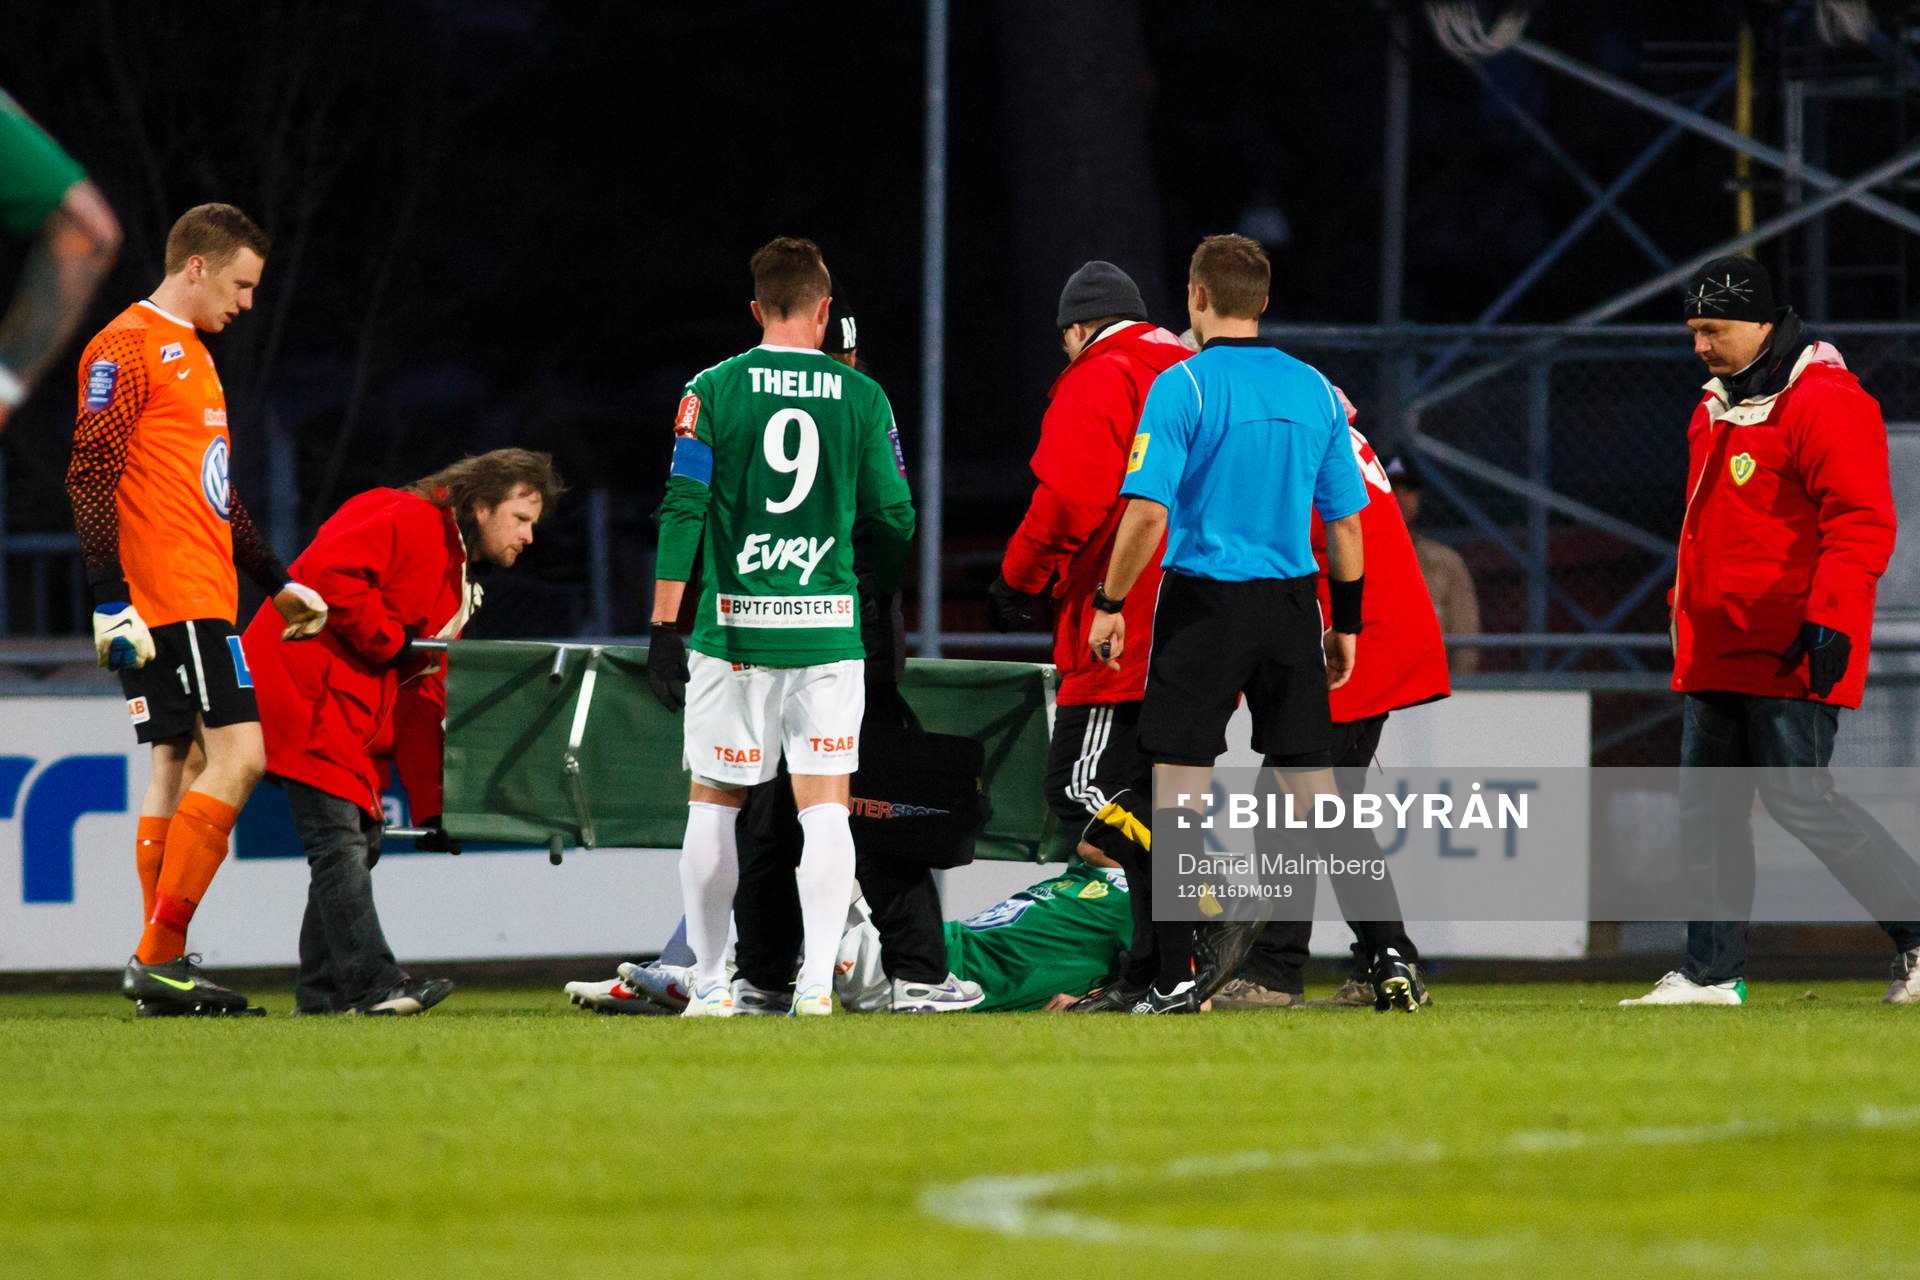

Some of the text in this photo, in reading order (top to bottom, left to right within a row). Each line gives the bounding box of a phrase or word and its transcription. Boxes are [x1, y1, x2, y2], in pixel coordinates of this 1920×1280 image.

[748, 367, 842, 400] THELIN
[763, 407, 820, 514] 9
[176, 664, 192, 695] 1
[714, 745, 762, 763] TSAB
[809, 736, 855, 752] TSAB
[1202, 778, 1540, 859] RULT
